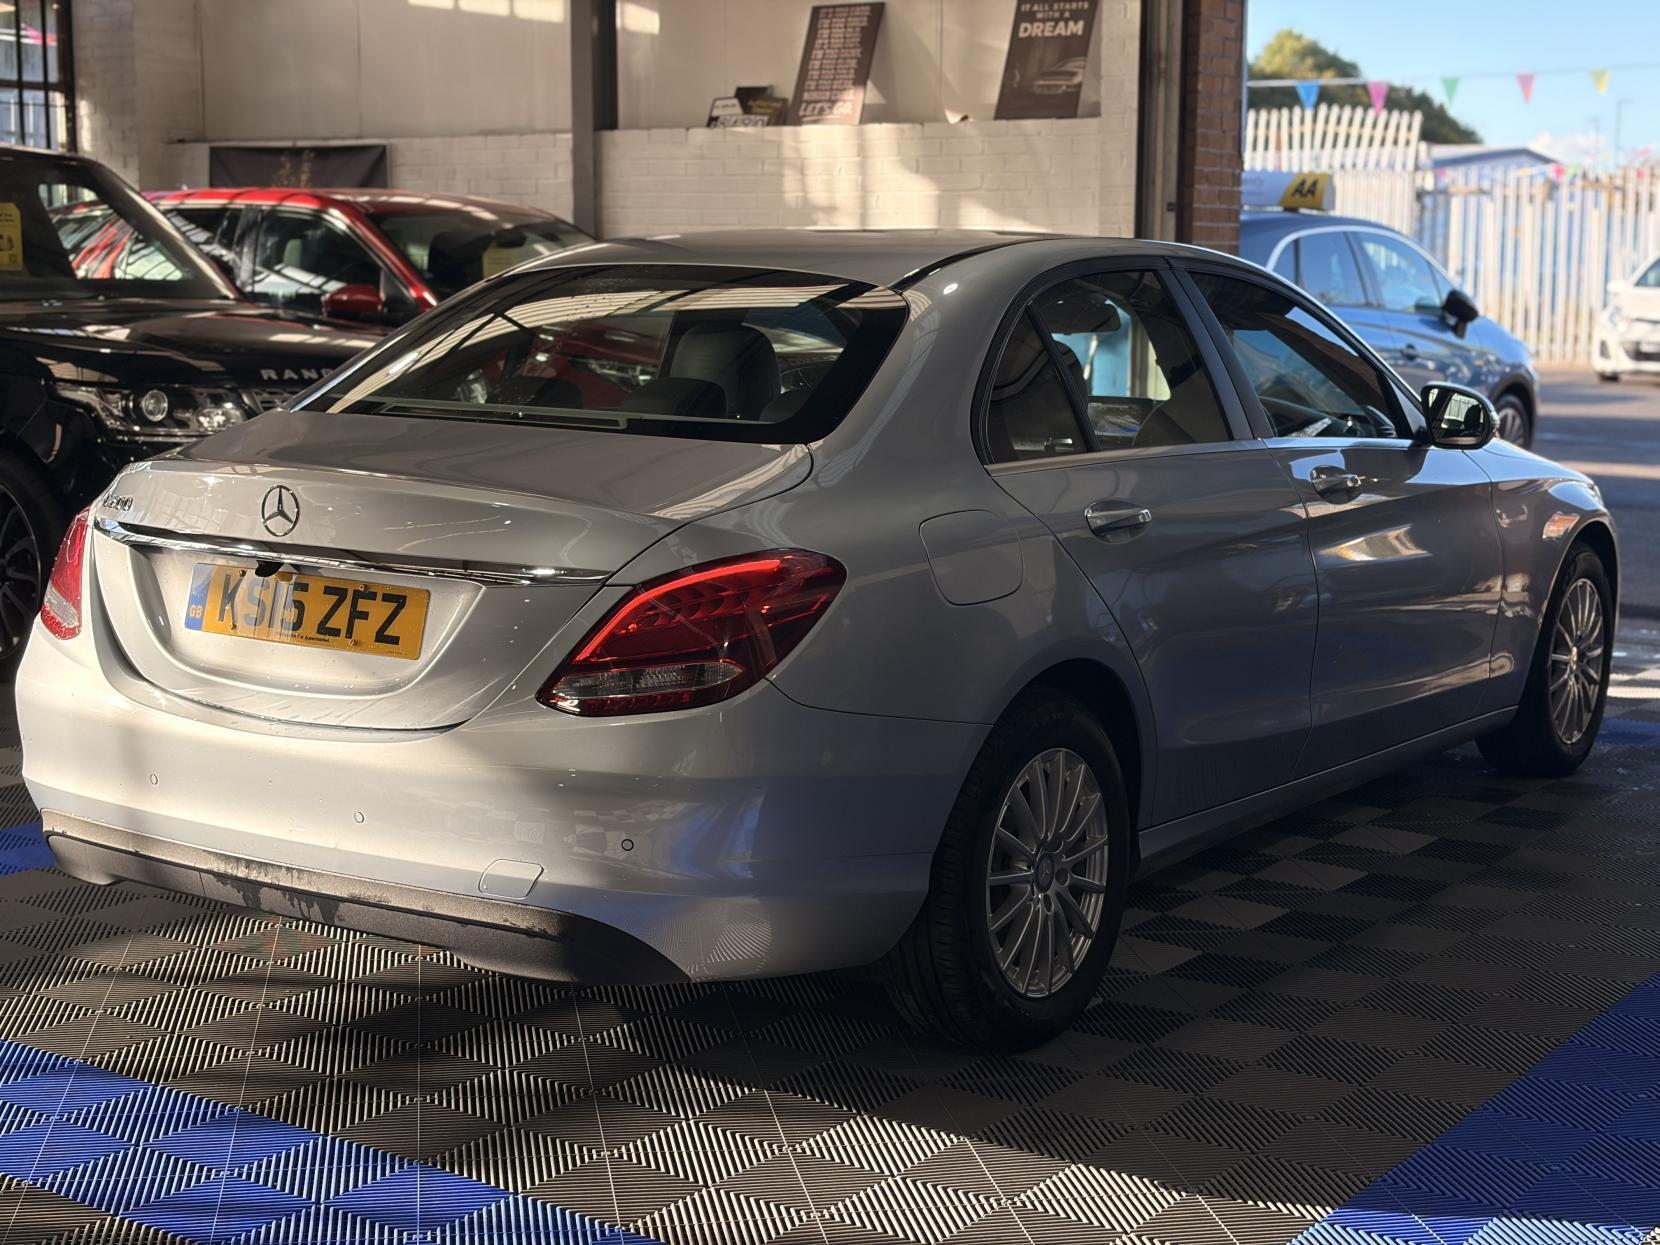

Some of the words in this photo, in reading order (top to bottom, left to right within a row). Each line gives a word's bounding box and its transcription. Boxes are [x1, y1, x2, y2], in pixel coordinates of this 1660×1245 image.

[1032, 3, 1049, 11] ALL
[1053, 1, 1089, 10] STARTS
[1036, 11, 1061, 19] WITH
[1018, 20, 1084, 38] DREAM
[1291, 179, 1319, 198] AA
[189, 604, 203, 618] GB
[217, 573, 309, 632] KS15
[316, 584, 408, 646] ZFZ
